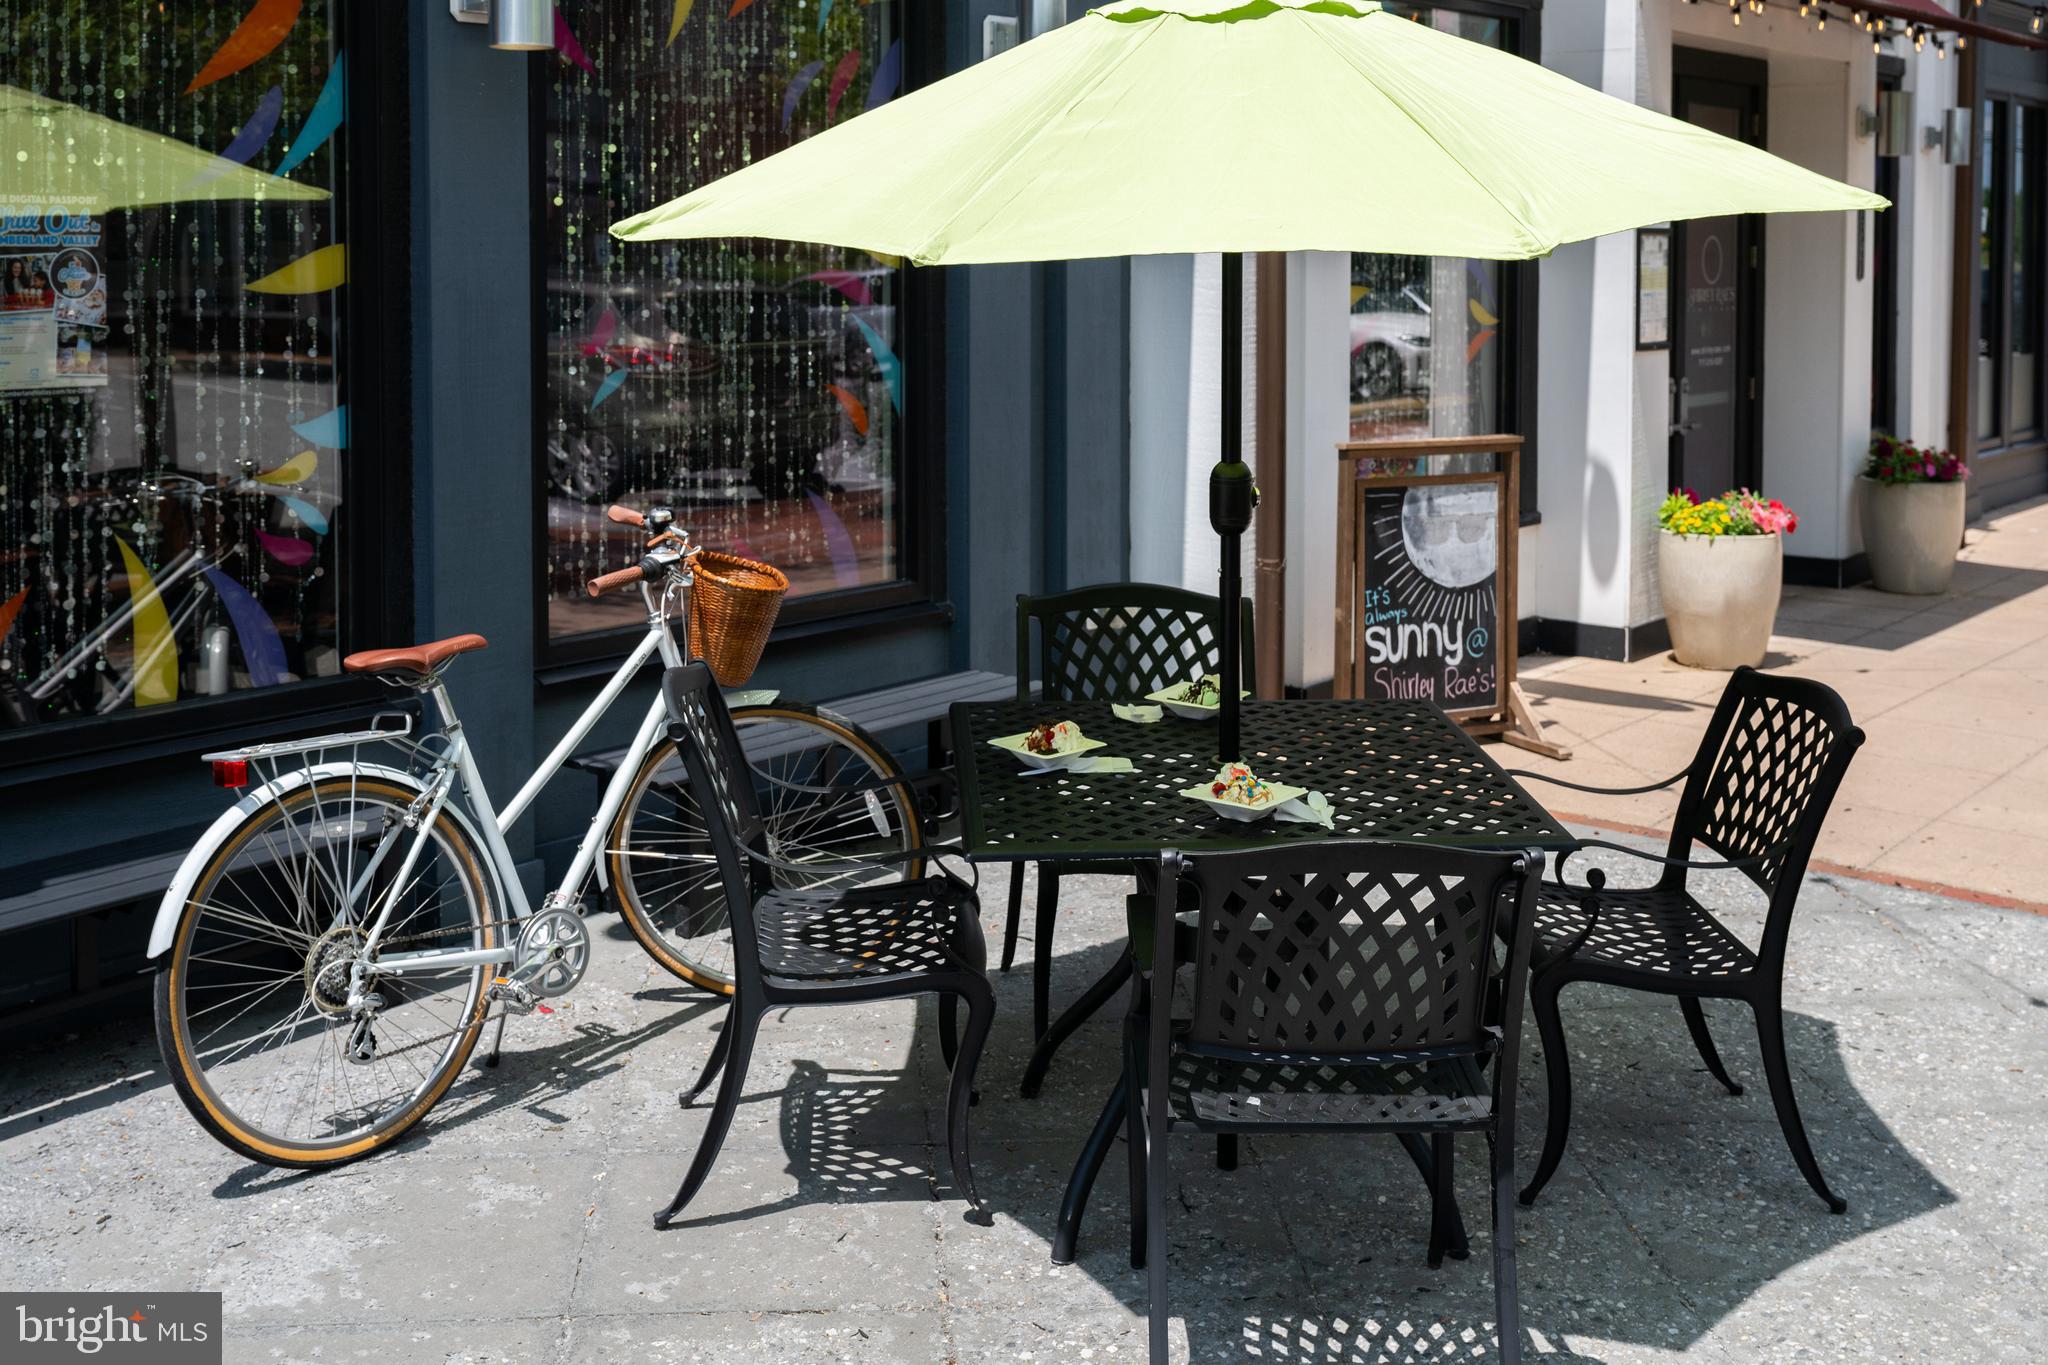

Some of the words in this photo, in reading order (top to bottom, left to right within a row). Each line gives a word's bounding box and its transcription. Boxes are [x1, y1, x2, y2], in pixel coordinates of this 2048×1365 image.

[9, 194, 47, 204] DIGITAL
[49, 195, 97, 204] PASSPORT
[45, 205, 91, 235] Out
[61, 235, 100, 247] VALLEY
[1365, 586, 1391, 607] It's
[1365, 607, 1408, 625] always
[1365, 620, 1463, 666] sunny
[1466, 627, 1488, 658] @
[1374, 666, 1435, 701] Shirley
[1444, 664, 1496, 699] Rae's!
